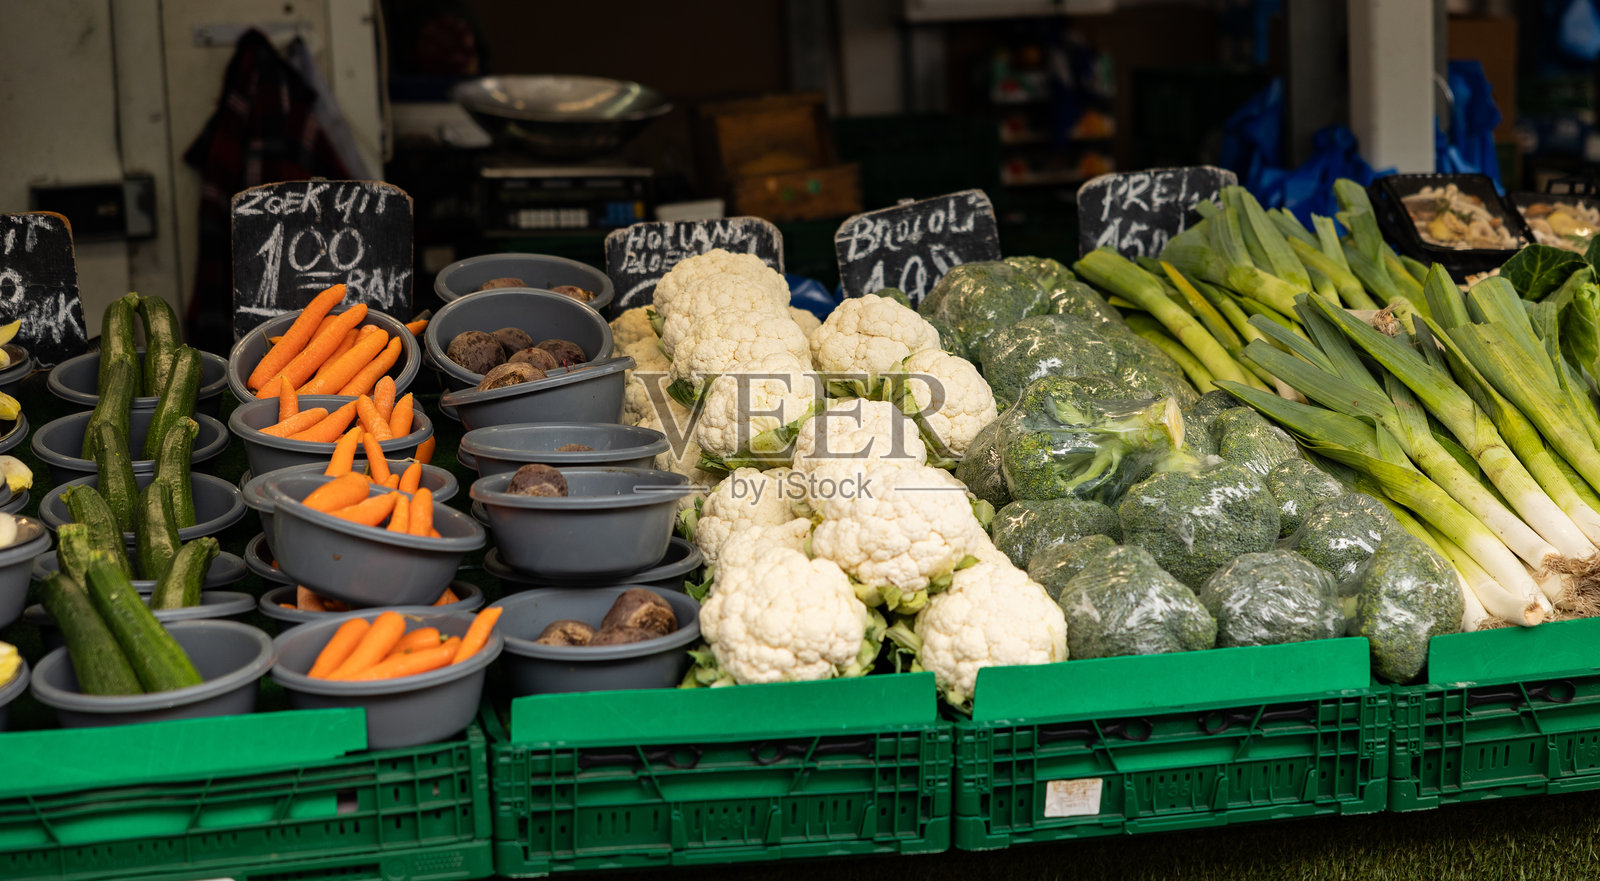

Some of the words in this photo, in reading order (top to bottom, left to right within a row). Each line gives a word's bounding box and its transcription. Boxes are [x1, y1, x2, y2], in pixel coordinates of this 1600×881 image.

[235, 183, 331, 219] ZOEK
[255, 221, 365, 307] 100
[342, 267, 412, 309] BAK
